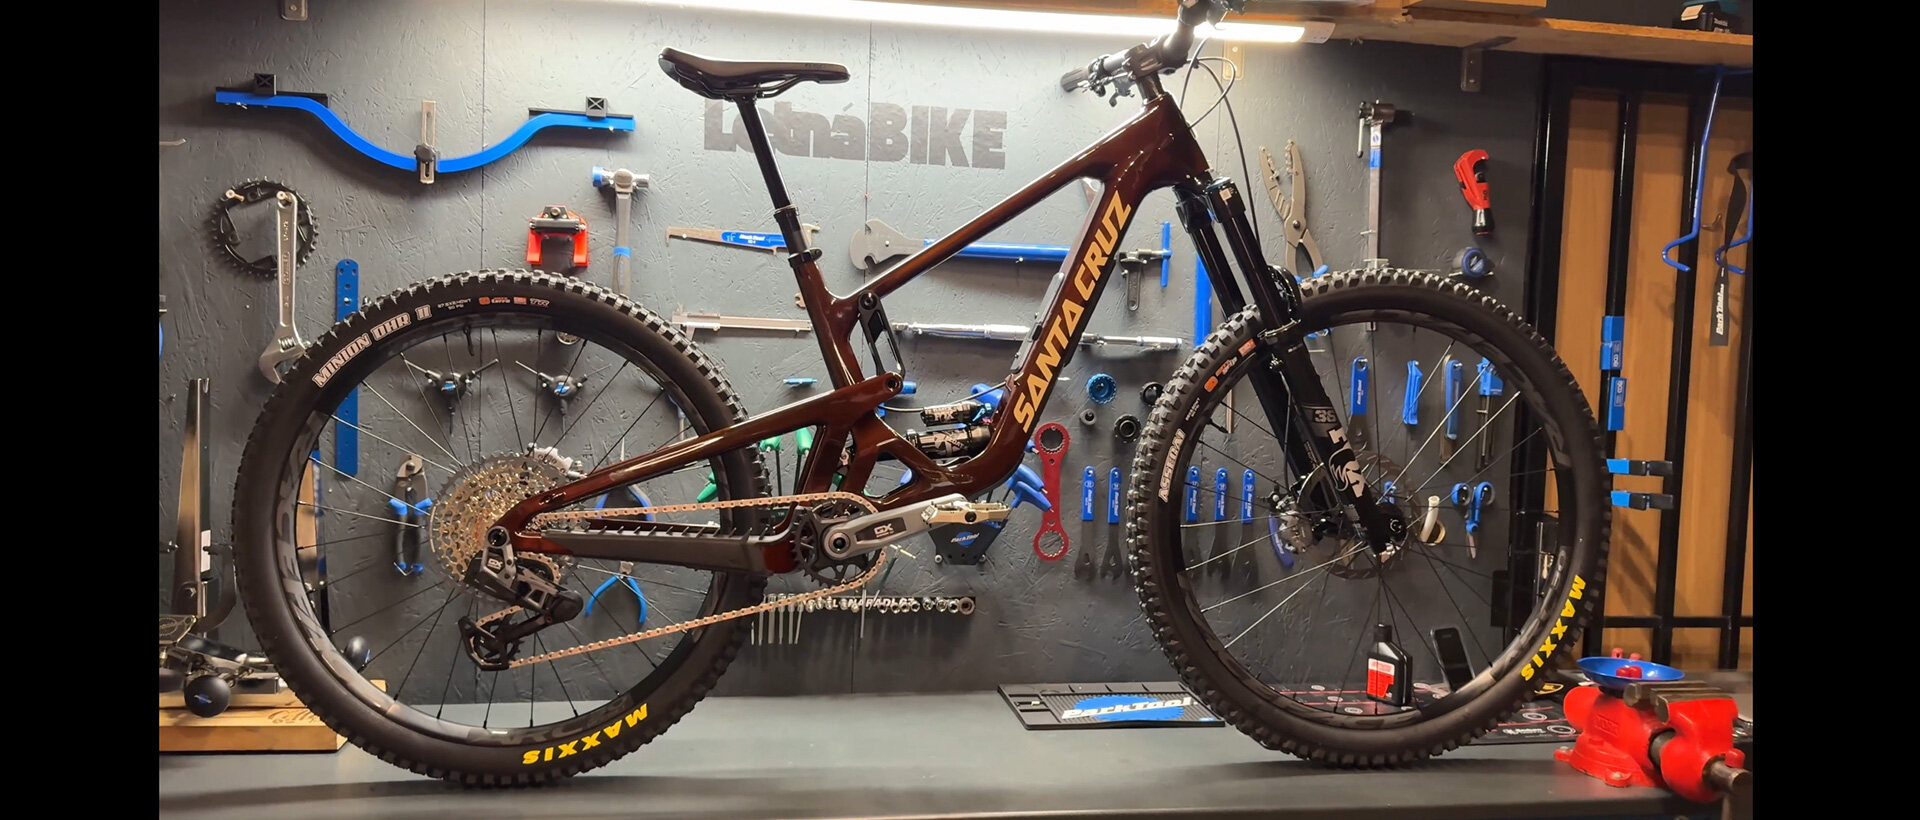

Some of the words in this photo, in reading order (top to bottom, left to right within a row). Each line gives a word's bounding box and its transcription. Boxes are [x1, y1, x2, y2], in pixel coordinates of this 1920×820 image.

[312, 333, 372, 388] MINION
[370, 312, 412, 342] DHR
[1012, 298, 1085, 434] SANTA
[1073, 190, 1132, 302] CRUZ
[874, 523, 894, 535] GX
[1521, 574, 1586, 681] MAXXIS
[522, 703, 648, 764] MAXXIS
